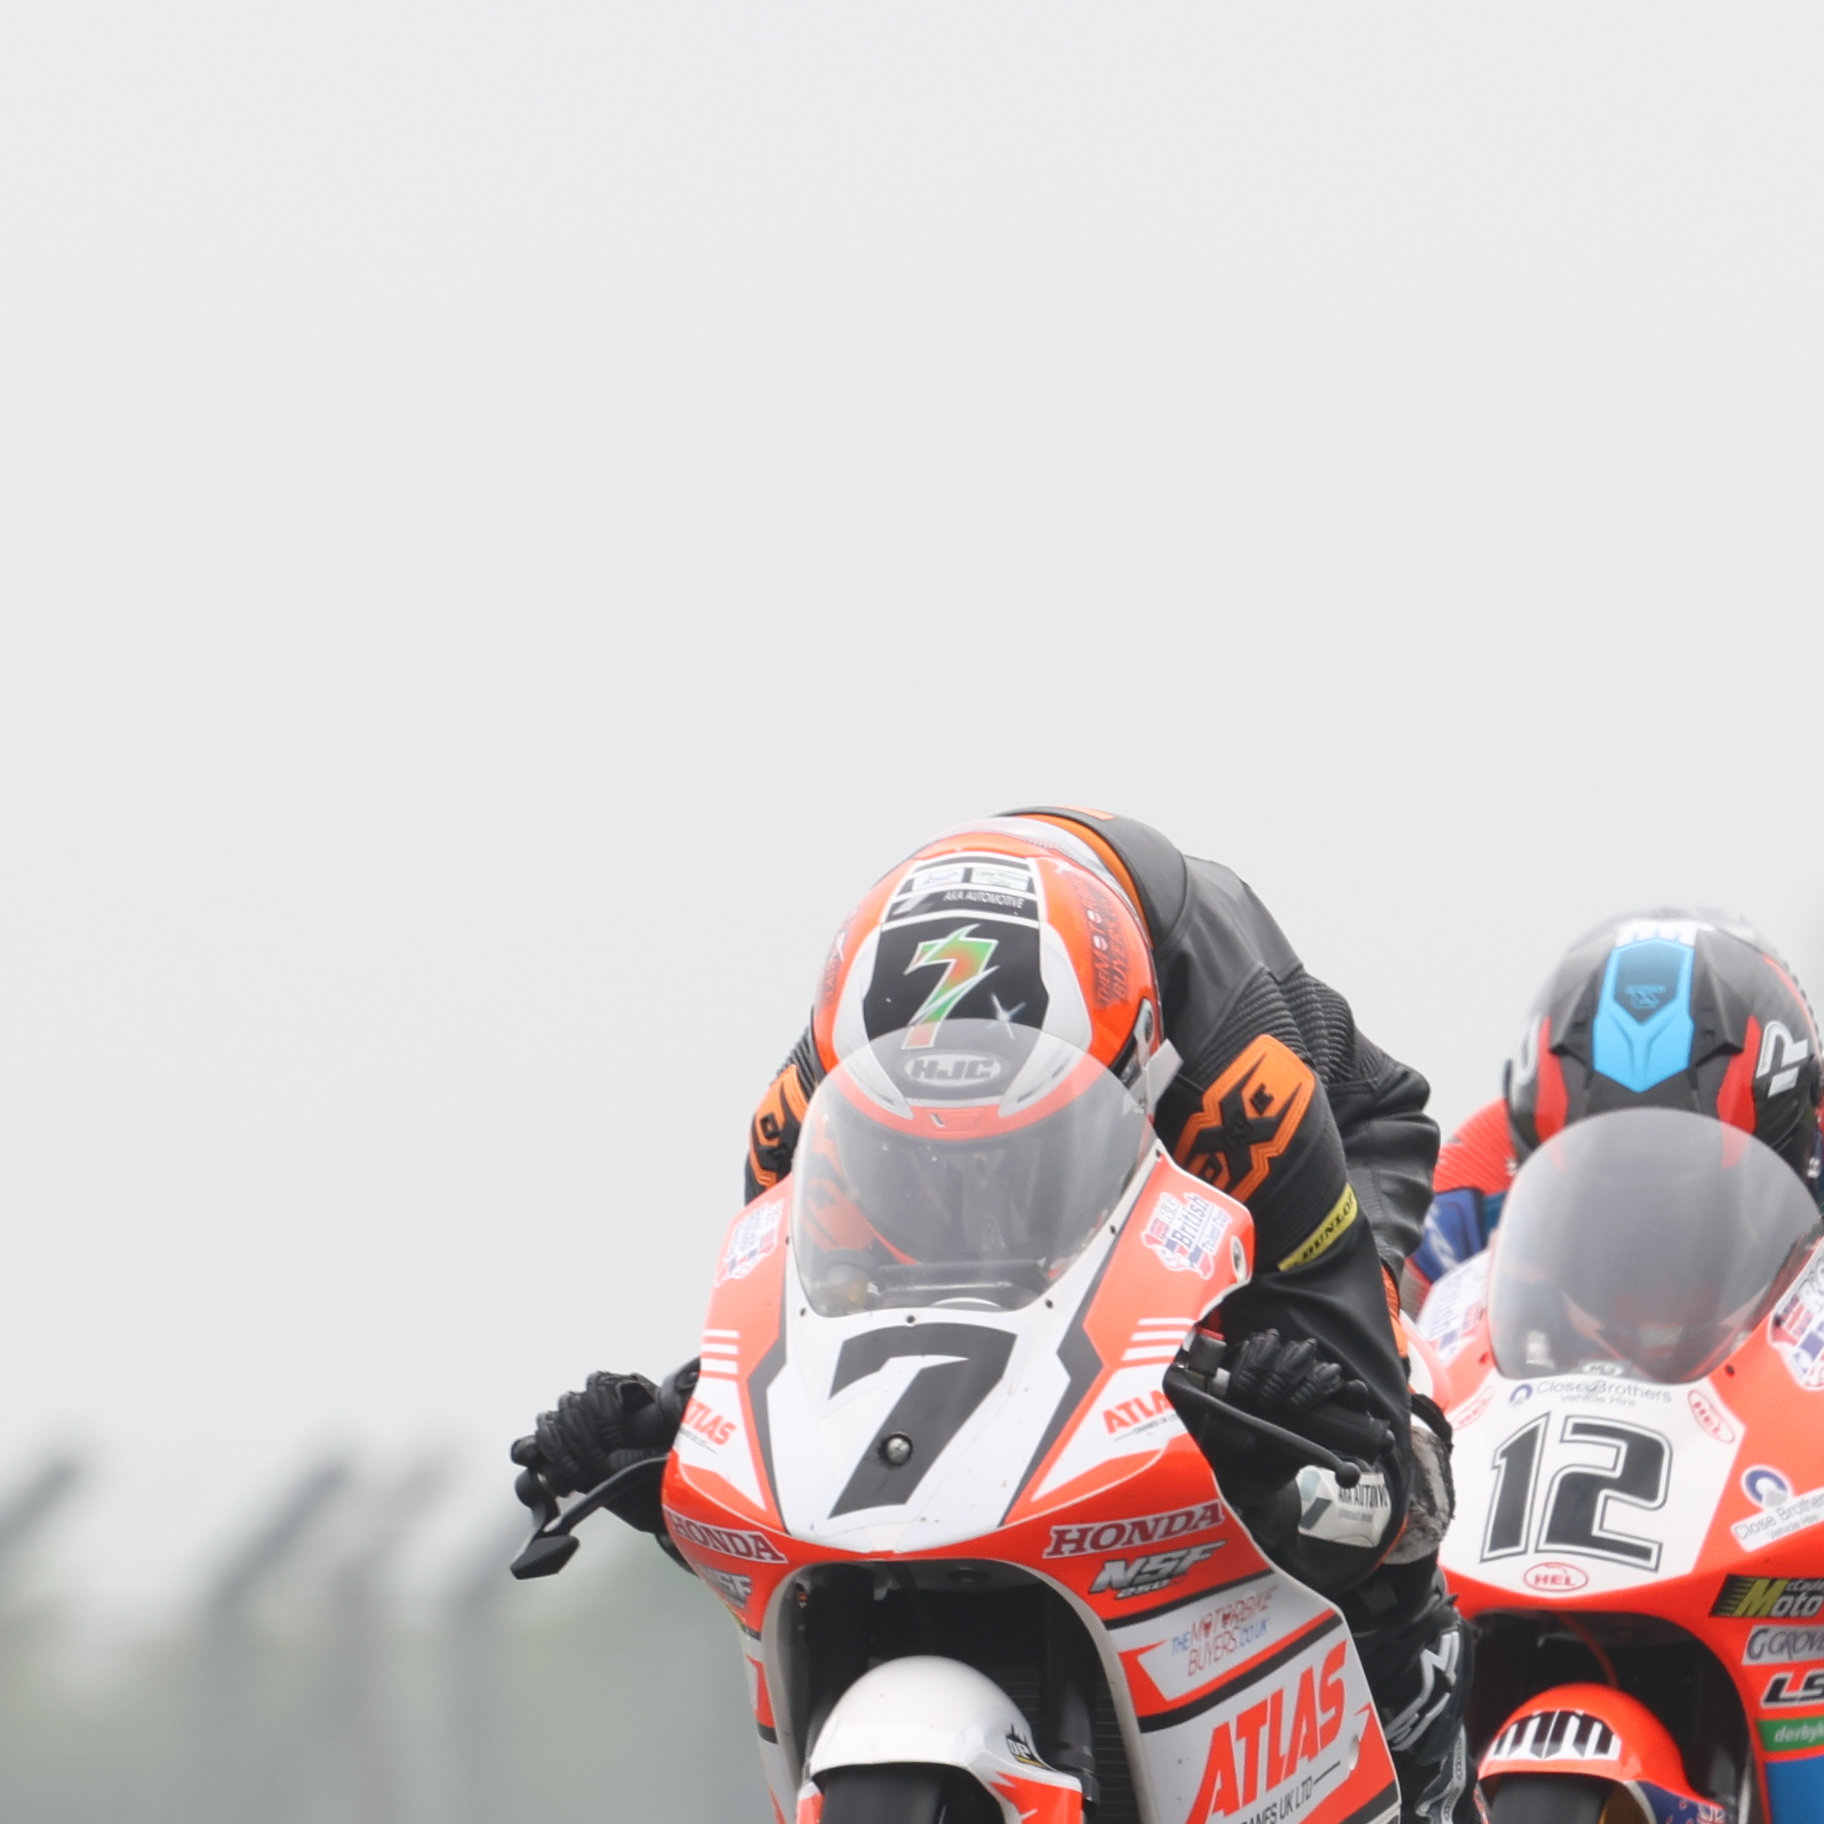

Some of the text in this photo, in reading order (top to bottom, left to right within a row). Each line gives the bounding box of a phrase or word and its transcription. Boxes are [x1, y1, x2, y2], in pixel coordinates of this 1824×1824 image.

[902, 924, 999, 1050] 7
[910, 1059, 994, 1081] HJC
[1176, 1195, 1209, 1248] British
[1101, 1389, 1175, 1435] ATLA
[1536, 1380, 1673, 1404] Close Brothers
[1609, 1395, 1637, 1408] Hire
[828, 1322, 1018, 1520] 7
[1479, 1410, 1673, 1573] 12
[670, 1510, 783, 1562] HONDA
[1045, 1503, 1224, 1557] HONDA
[1733, 1514, 1776, 1541] Close
[1089, 1540, 1226, 1594] NSF
[1278, 1793, 1295, 1821] UK
[1294, 1775, 1313, 1805] LTD
